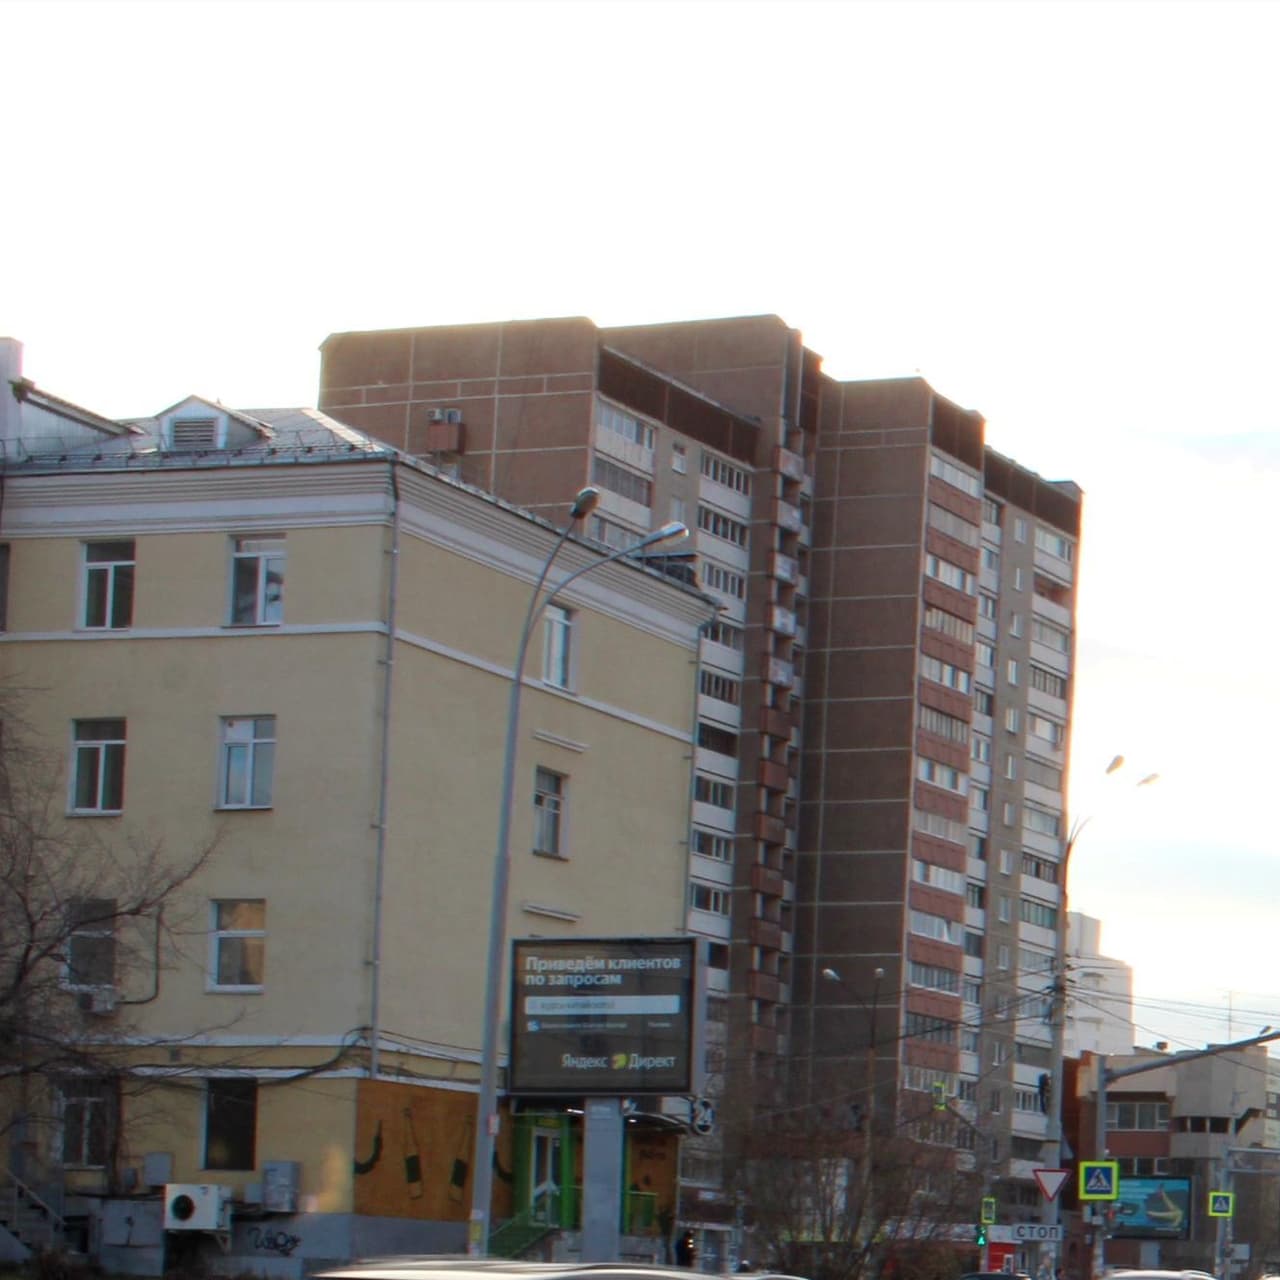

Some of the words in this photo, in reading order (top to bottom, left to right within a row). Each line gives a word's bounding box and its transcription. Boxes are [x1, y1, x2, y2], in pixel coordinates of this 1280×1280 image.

[525, 956, 605, 972] Приведём
[608, 957, 681, 970] клиентов
[525, 975, 544, 985] по
[548, 974, 622, 988] запросам
[561, 1054, 608, 1069] Яндекс
[628, 1055, 676, 1070] Директ
[1016, 1226, 1060, 1239] СТОП
